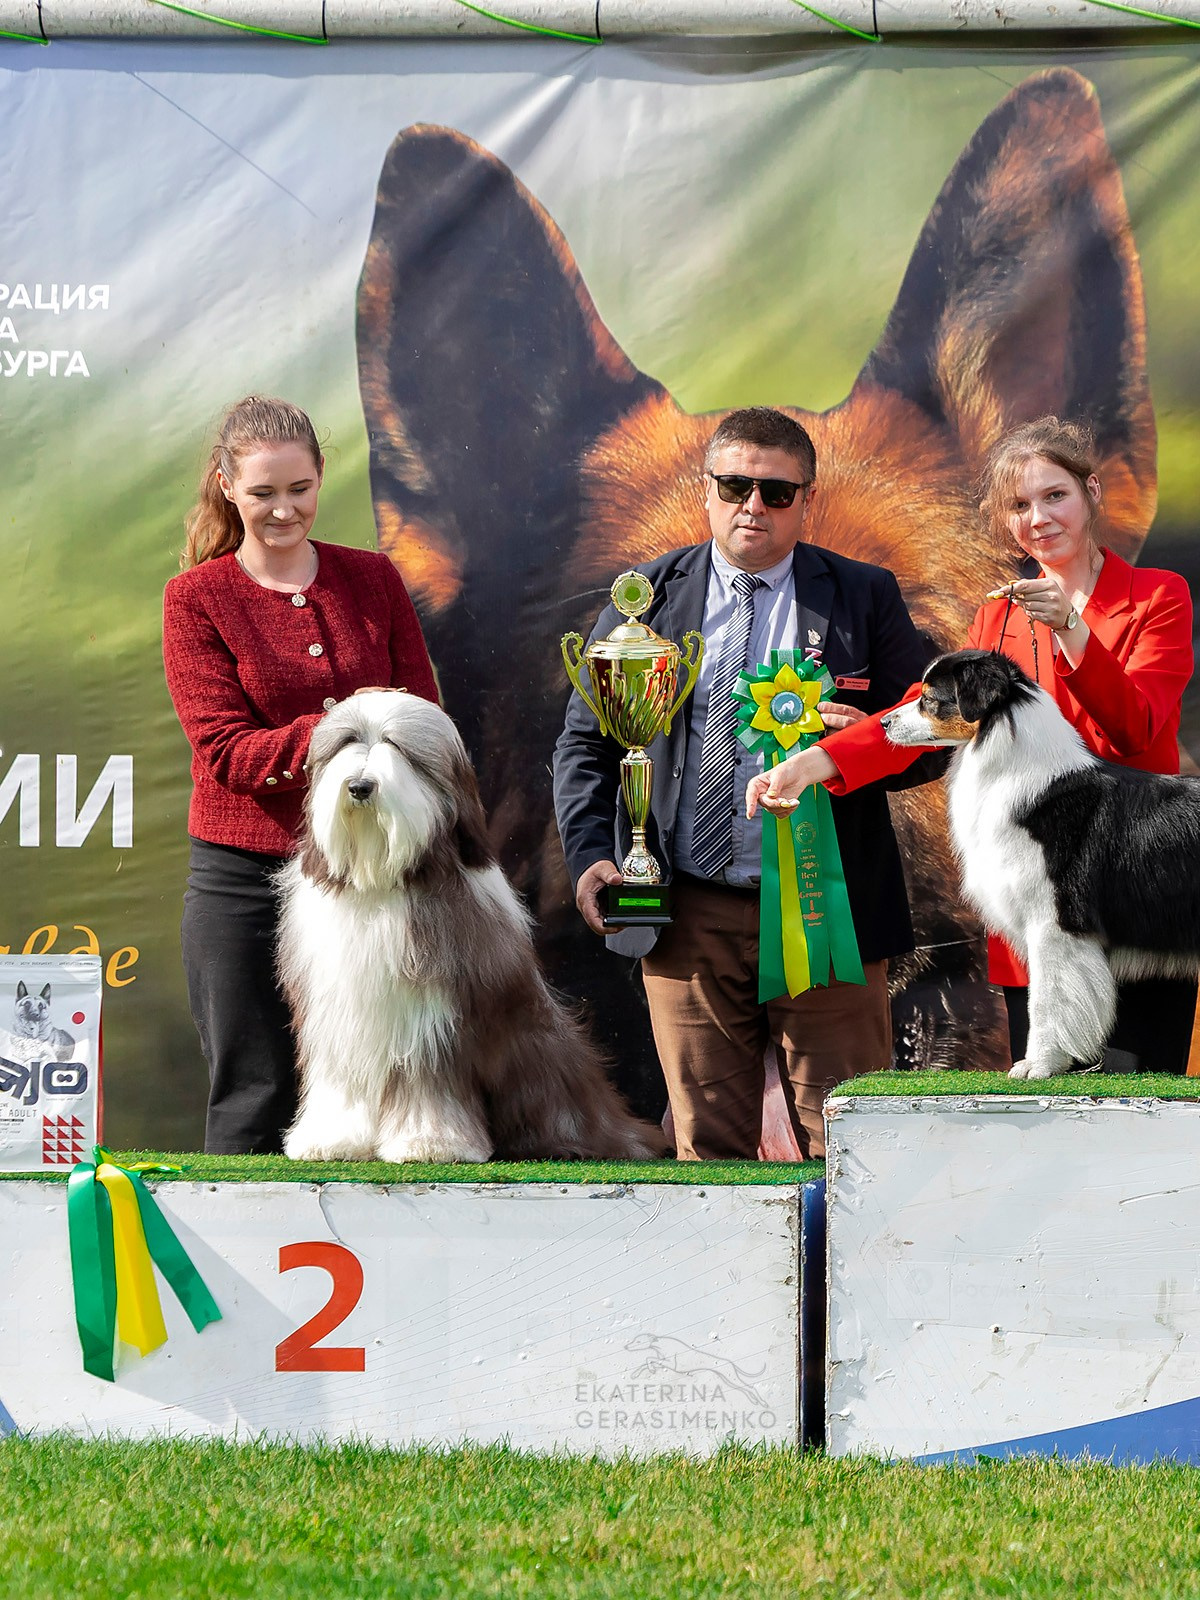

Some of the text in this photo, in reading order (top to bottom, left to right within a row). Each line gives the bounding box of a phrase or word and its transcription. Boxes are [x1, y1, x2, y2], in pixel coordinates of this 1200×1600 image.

[0, 350, 90, 377] УРГА
[8, 1109, 37, 1118] ADULT
[275, 1242, 365, 1372] 2
